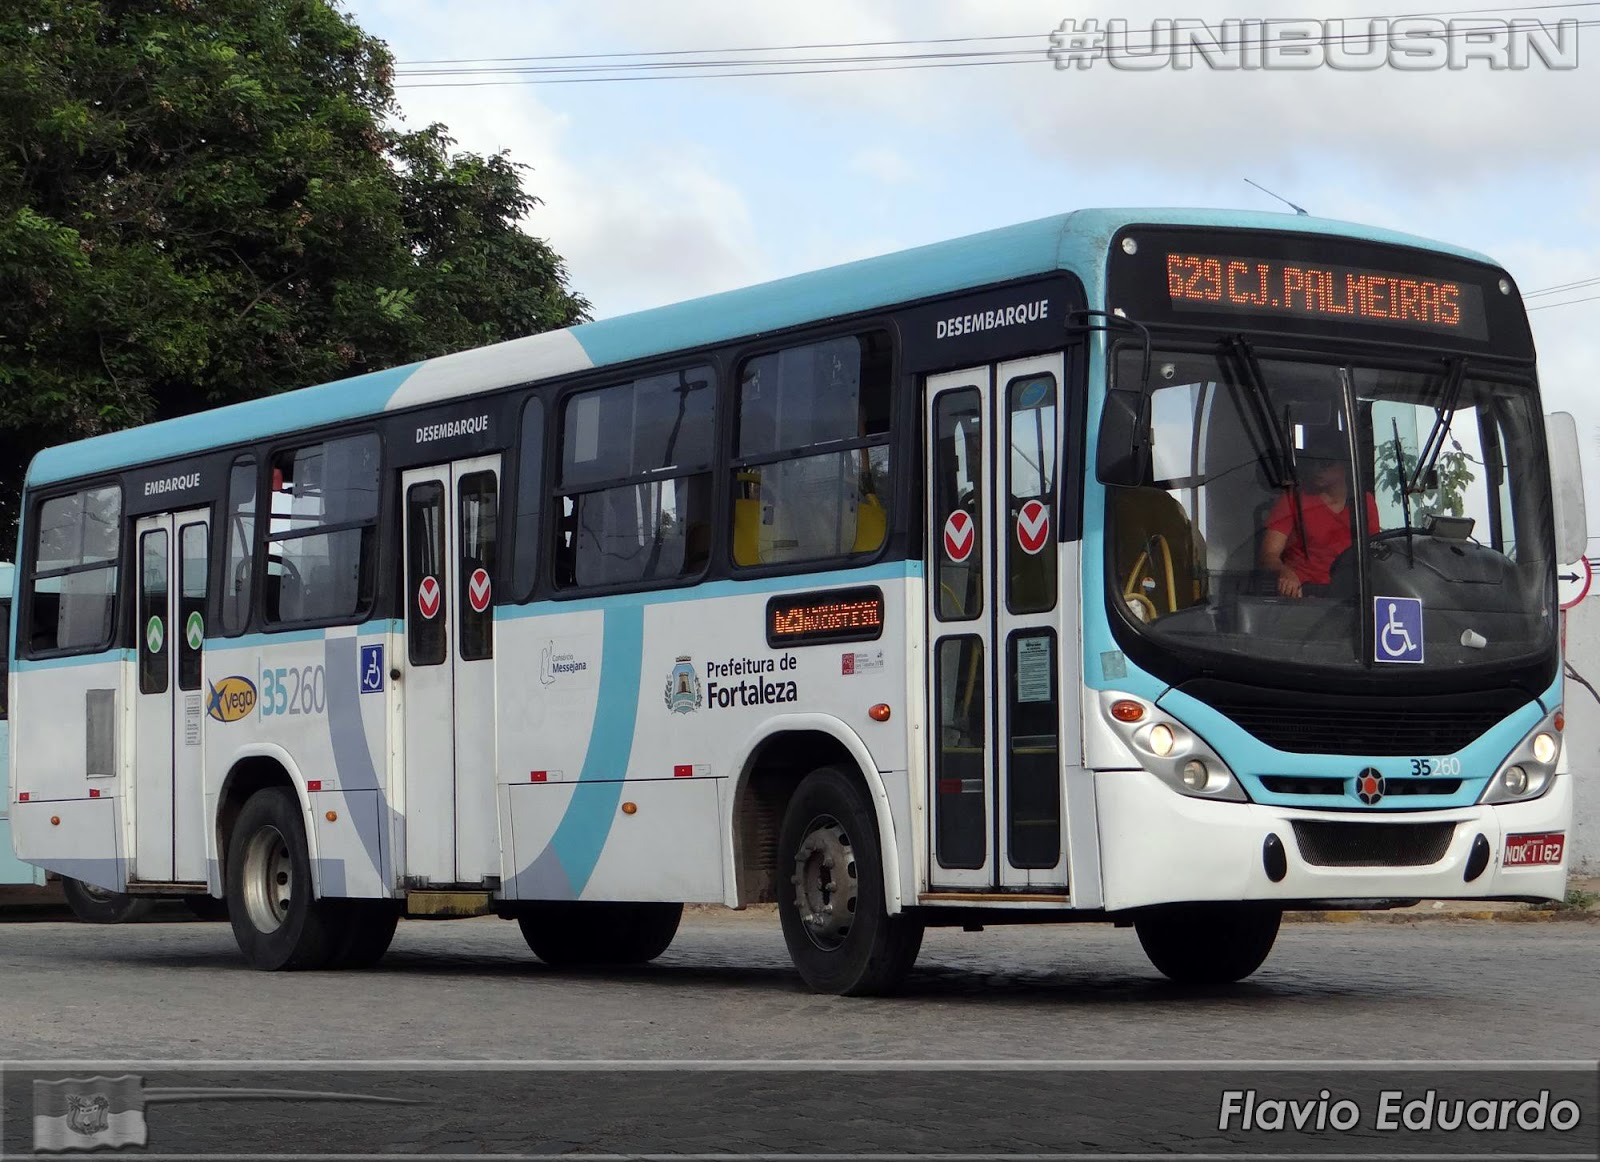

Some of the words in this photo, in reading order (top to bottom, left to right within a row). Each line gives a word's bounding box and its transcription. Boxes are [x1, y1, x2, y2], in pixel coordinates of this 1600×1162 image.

[1167, 253, 1221, 300] 629
[936, 299, 1048, 339] DESEMBARQUE
[415, 414, 489, 443] DESEMBARQUE
[144, 472, 200, 496] EMBARQUE
[552, 660, 587, 674] Messejana
[707, 657, 774, 678] Prefeitura
[780, 652, 797, 671] de
[262, 664, 326, 716] 35260
[707, 675, 798, 709] Fortaleza
[1410, 757, 1461, 776] 35260
